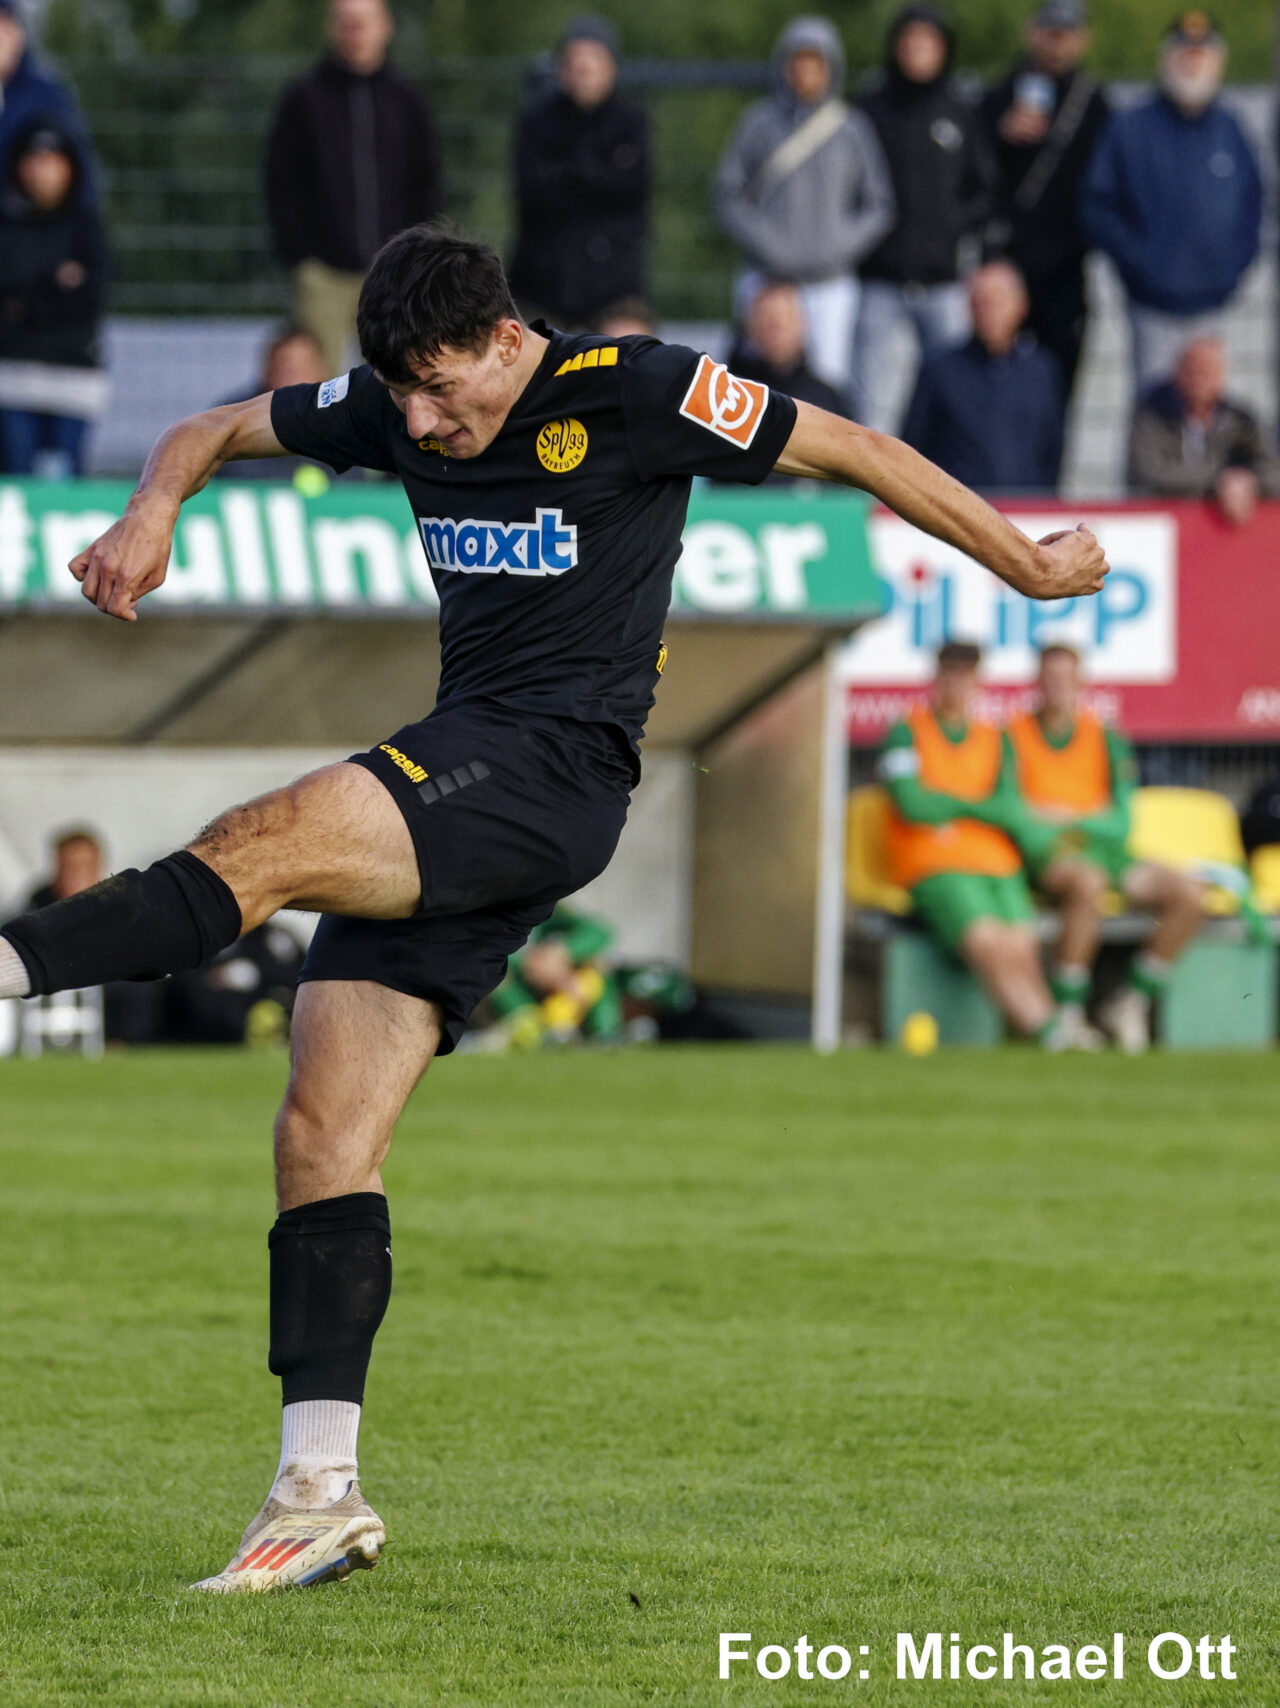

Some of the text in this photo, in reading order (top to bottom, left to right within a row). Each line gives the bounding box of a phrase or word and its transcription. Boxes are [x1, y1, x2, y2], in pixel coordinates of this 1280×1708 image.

[541, 453, 581, 470] BAYREUTH
[421, 509, 575, 573] maxit
[379, 744, 429, 783] capelli
